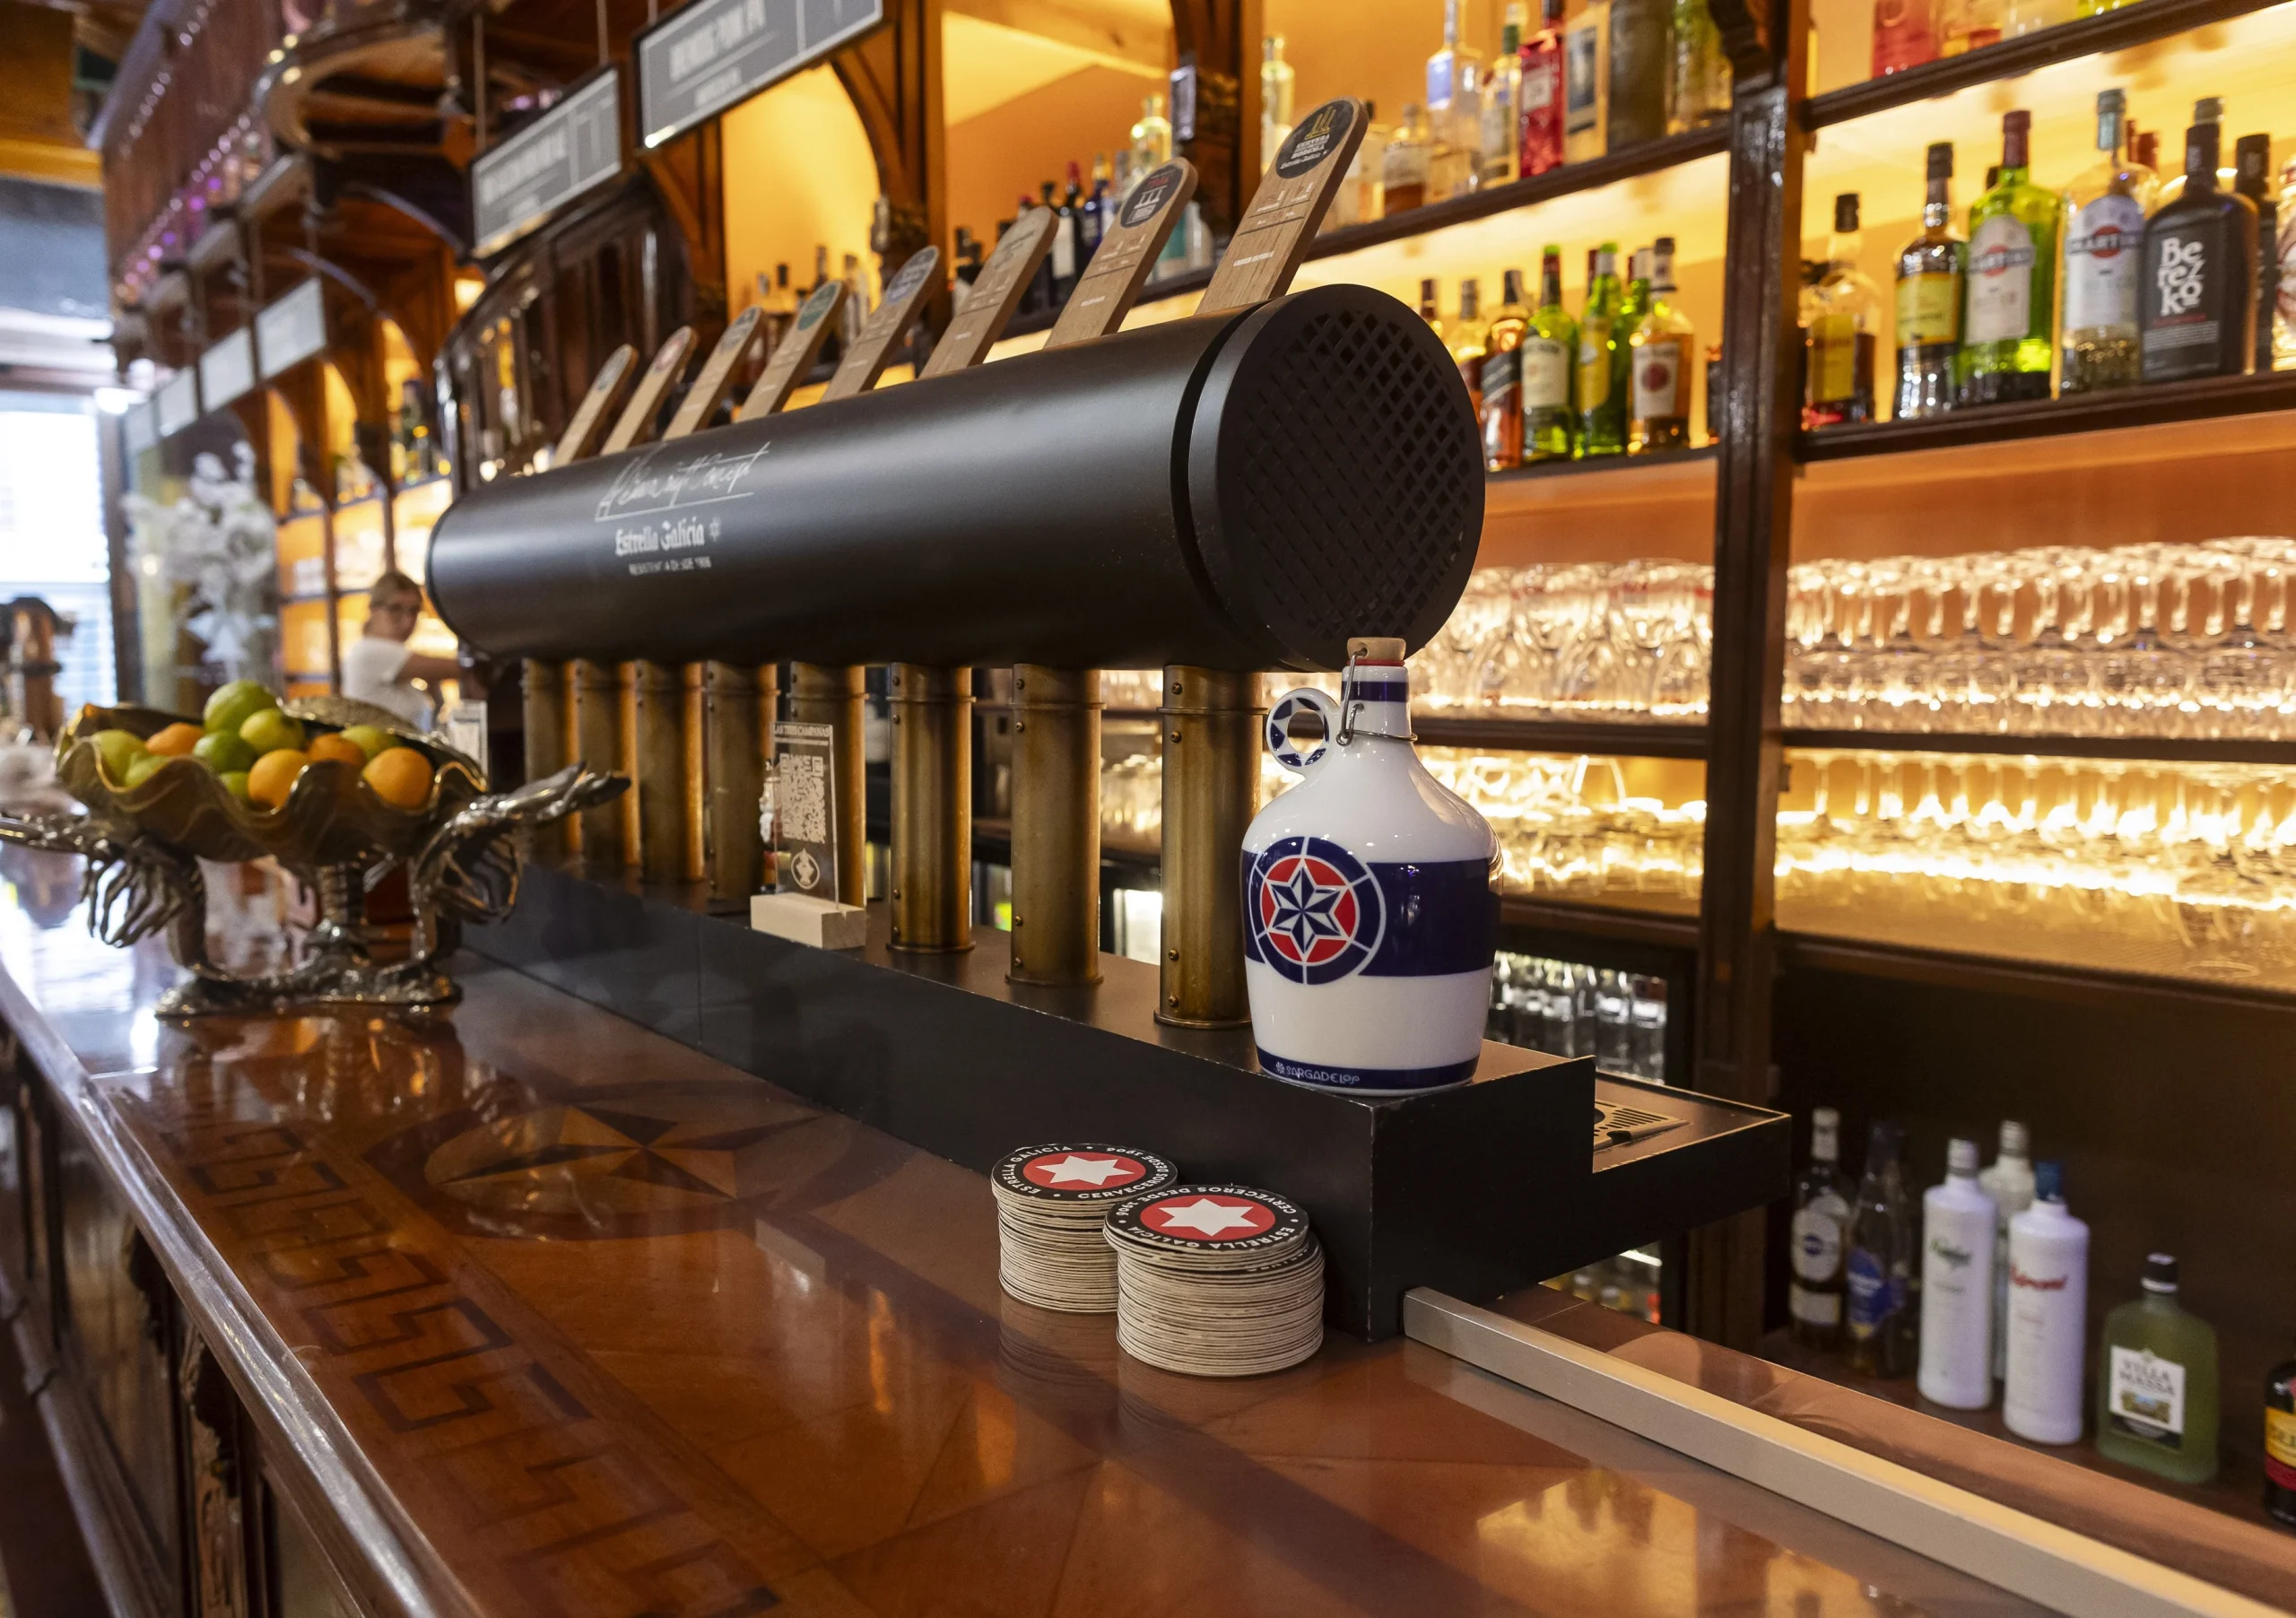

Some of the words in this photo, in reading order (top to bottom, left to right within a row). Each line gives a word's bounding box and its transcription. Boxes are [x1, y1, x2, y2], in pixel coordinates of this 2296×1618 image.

[1013, 1145, 1073, 1162] GALICIA
[1106, 1147, 1144, 1156] 1906
[1142, 1155, 1170, 1175] DESDE
[1001, 1163, 1042, 1194] ESTRELLA
[1077, 1171, 1169, 1199] CERVECEROS
[1139, 1187, 1191, 1203] DESDE
[1196, 1186, 1297, 1214] CERVECEROS
[1116, 1201, 1139, 1216] 1906
[1126, 1226, 1200, 1248] GALICIA
[1208, 1226, 1296, 1250] ESTRELLA
